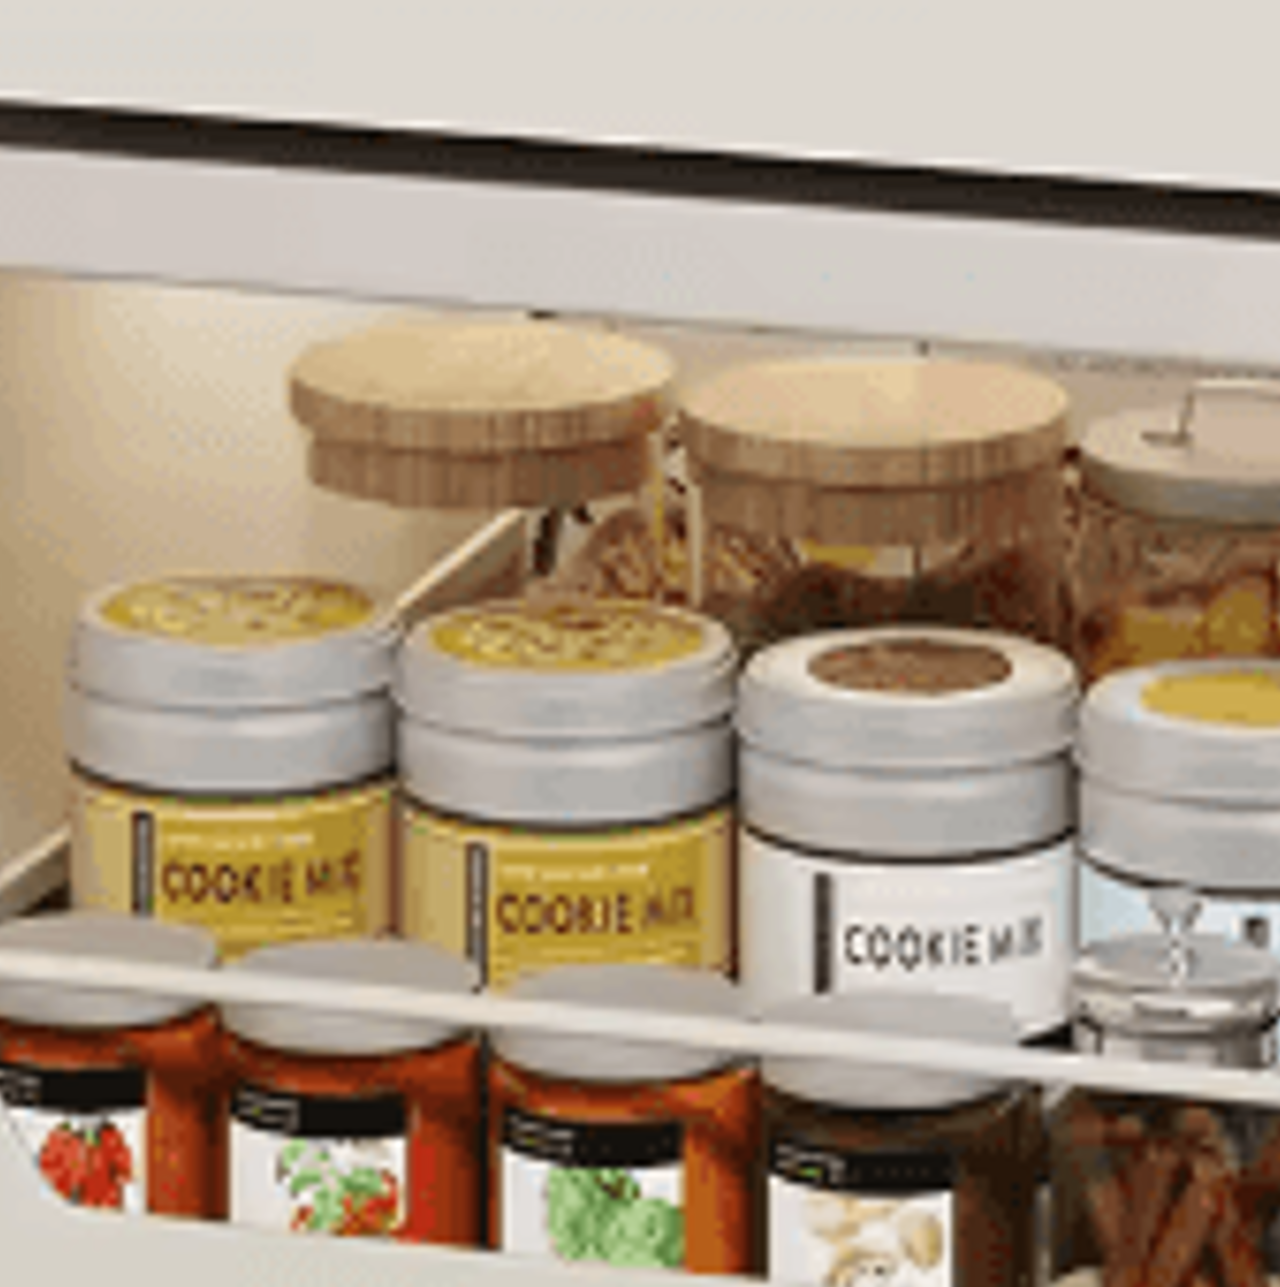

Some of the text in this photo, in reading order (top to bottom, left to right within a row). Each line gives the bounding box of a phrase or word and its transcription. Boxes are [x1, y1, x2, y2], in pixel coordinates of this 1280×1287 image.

[161, 862, 293, 904] COOKIE
[495, 891, 634, 936] COOKIE
[843, 923, 982, 972] COOKIE
